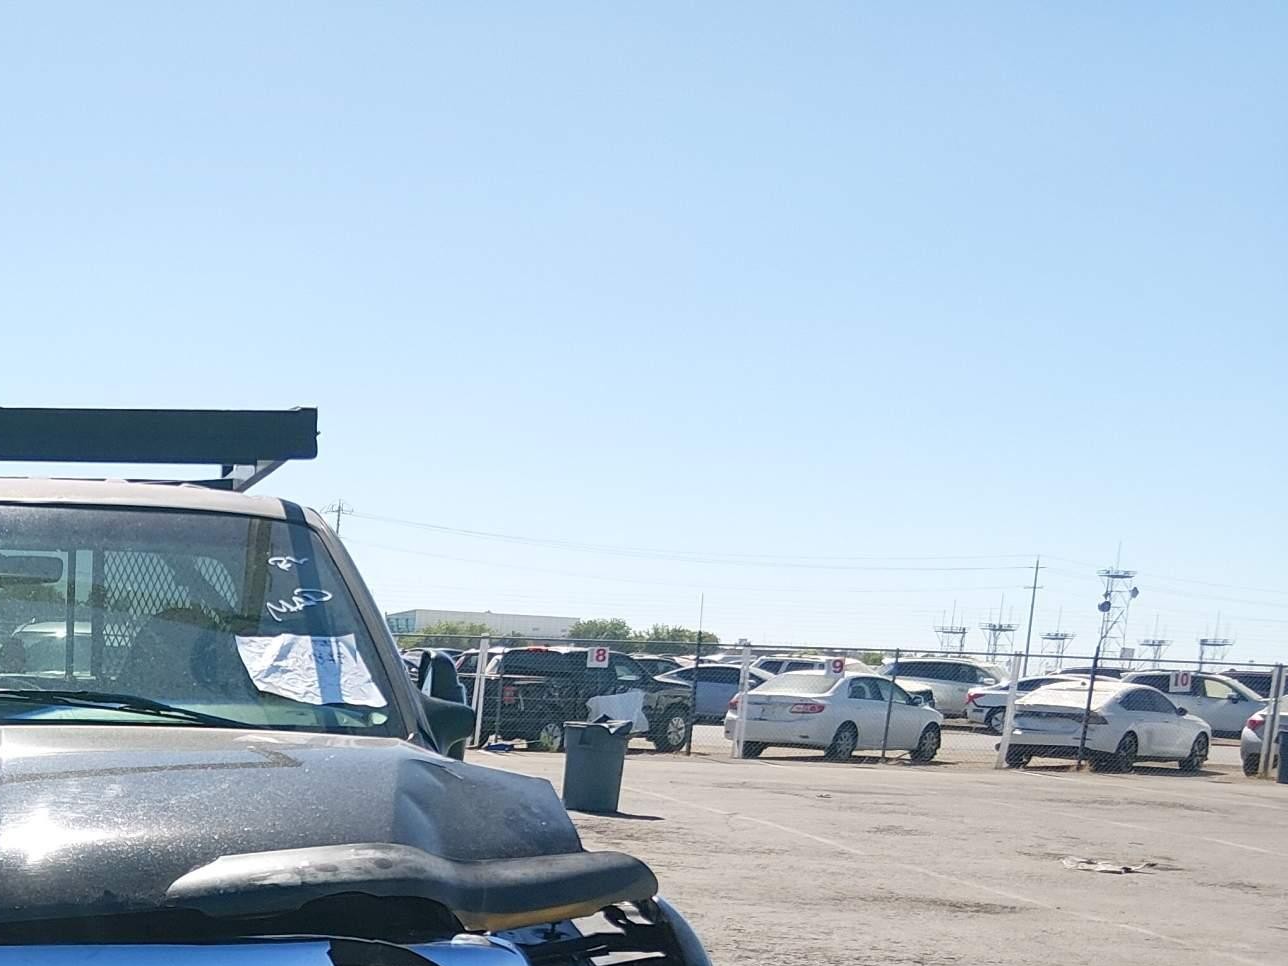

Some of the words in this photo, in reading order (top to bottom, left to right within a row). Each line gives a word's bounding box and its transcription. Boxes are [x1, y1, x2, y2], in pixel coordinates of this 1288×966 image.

[595, 647, 607, 663] 8
[831, 658, 844, 674] 9
[1173, 672, 1190, 687] 10
